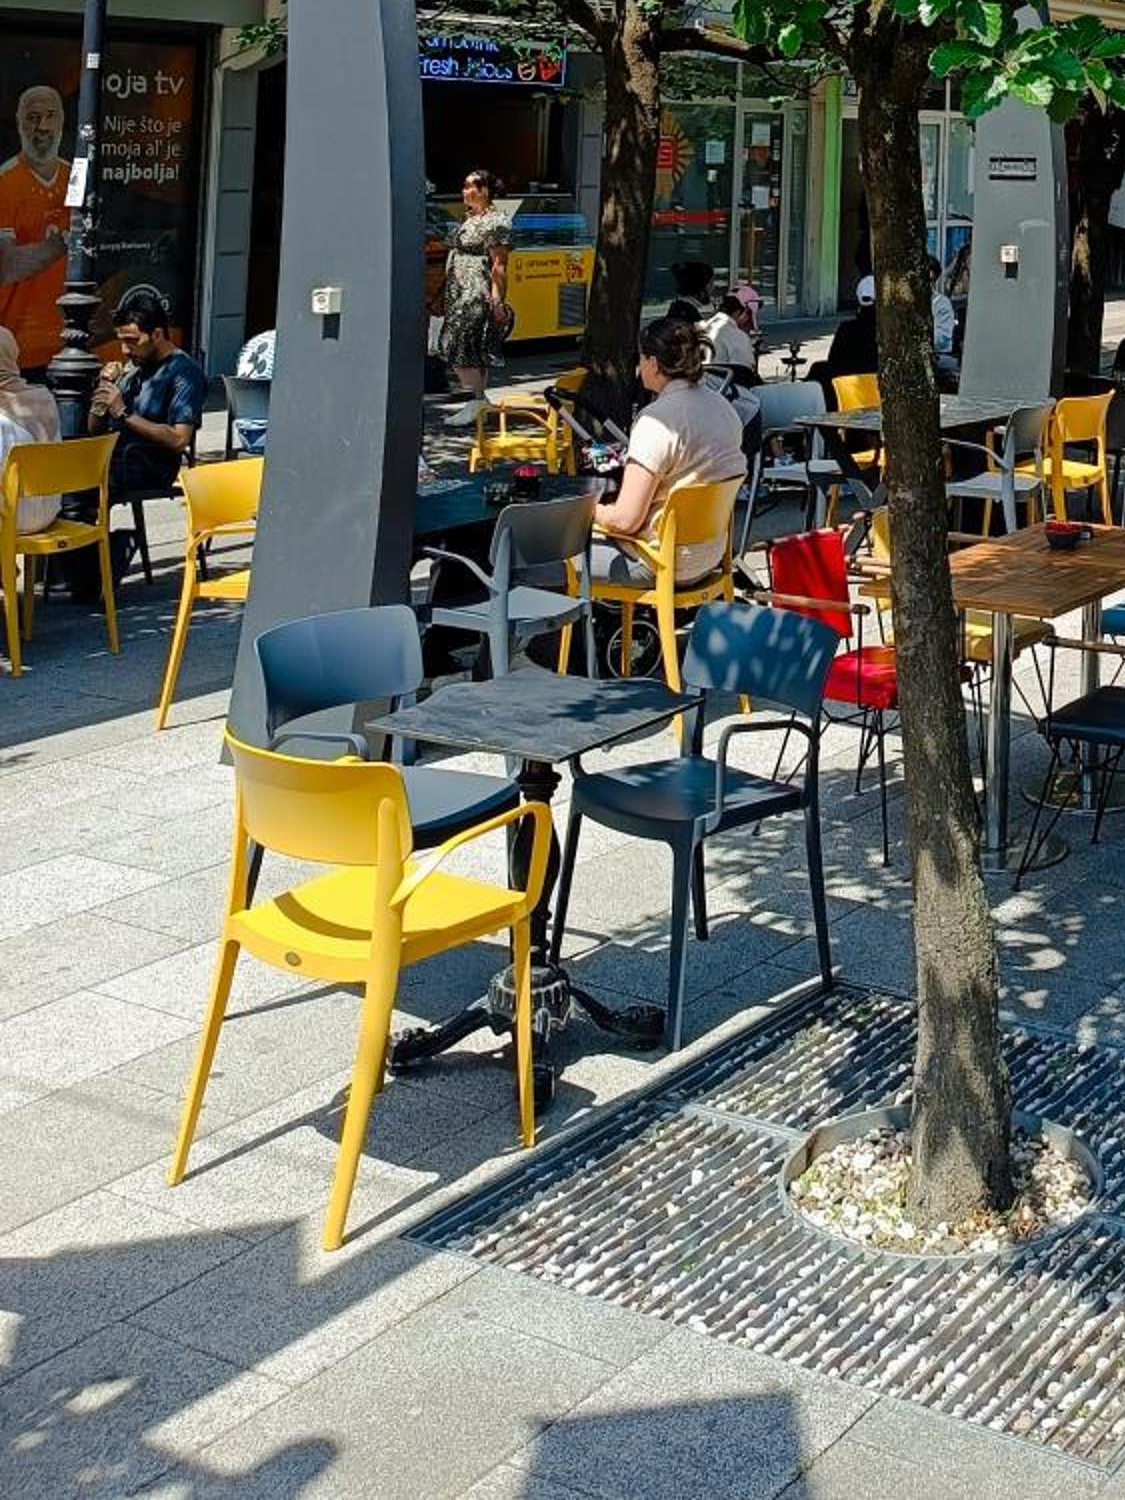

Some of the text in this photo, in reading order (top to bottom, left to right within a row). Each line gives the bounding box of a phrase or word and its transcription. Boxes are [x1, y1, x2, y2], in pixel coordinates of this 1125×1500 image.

[102, 68, 184, 98] oja tv
[104, 114, 182, 137] Nije što je
[101, 141, 141, 159] moja
[166, 141, 182, 160] je
[102, 163, 179, 184] najbolja!
